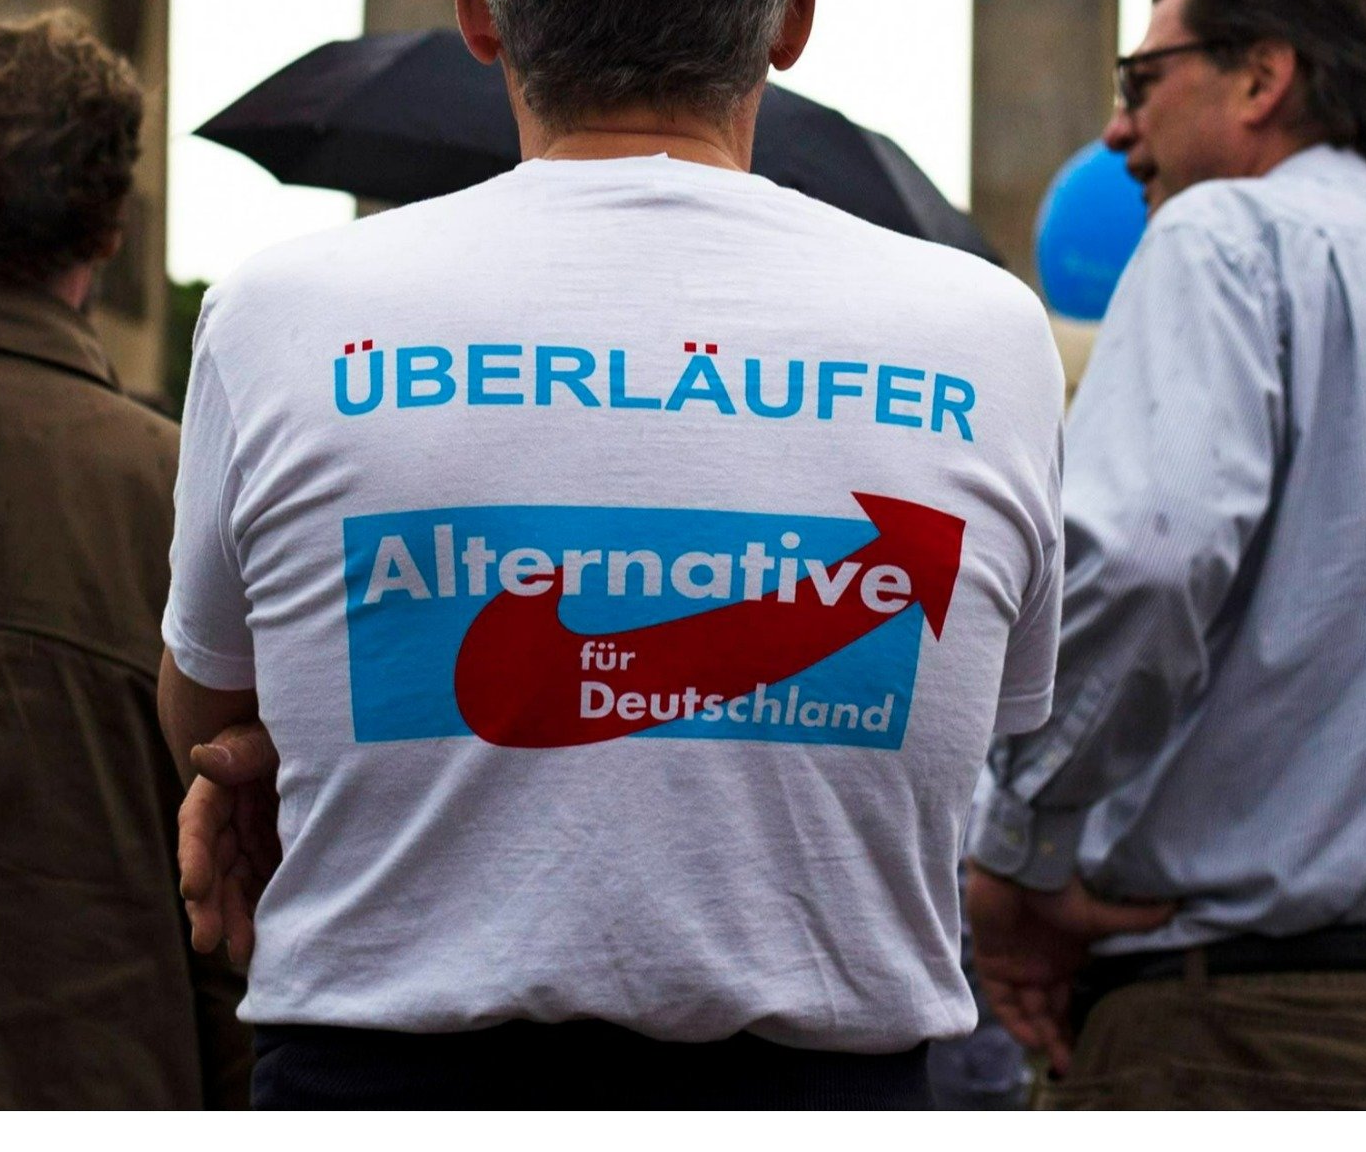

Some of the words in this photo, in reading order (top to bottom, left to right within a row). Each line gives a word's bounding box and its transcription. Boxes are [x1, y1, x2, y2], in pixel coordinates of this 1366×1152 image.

[333, 340, 976, 441] ÜBERLÄUFER
[362, 524, 912, 612] Alternative
[579, 640, 636, 671] für
[579, 680, 895, 733] Deutschland
